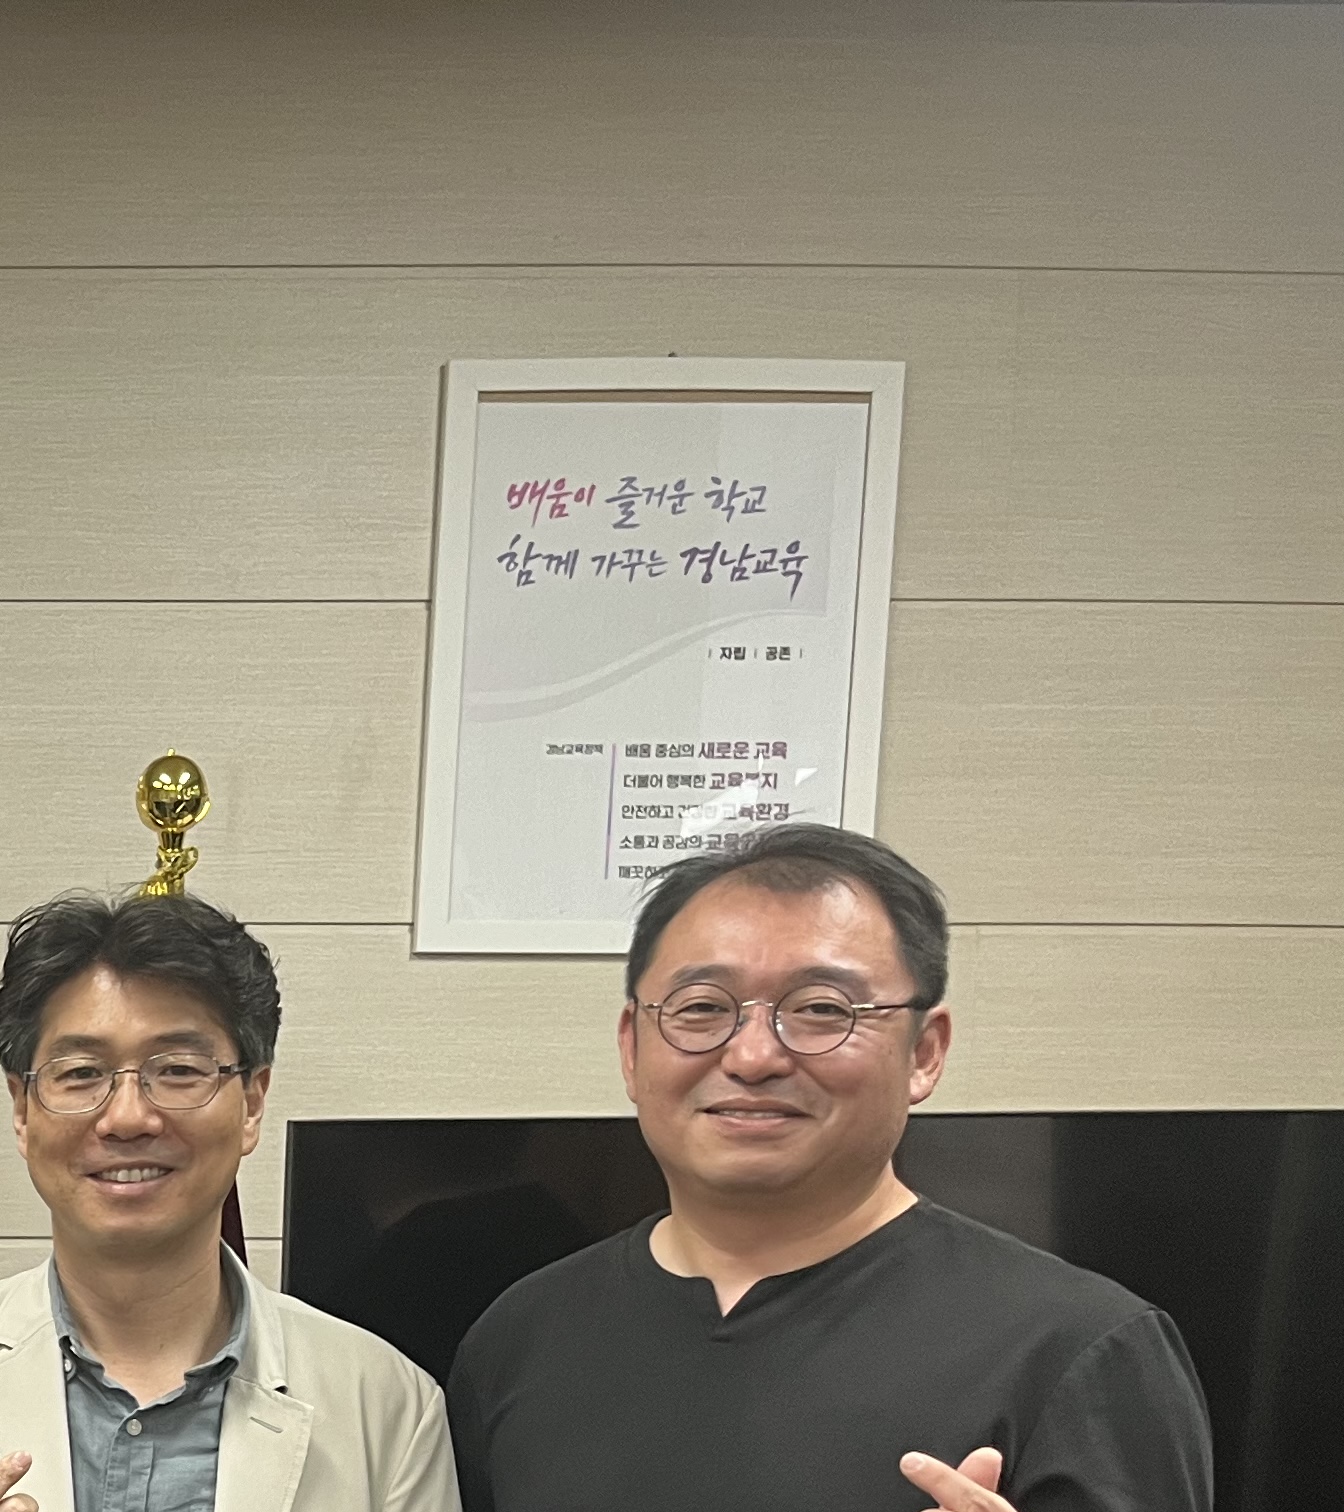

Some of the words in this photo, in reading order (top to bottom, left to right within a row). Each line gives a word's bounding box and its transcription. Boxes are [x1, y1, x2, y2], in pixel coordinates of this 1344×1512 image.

[506, 477, 597, 527] 배움이
[604, 476, 695, 529] 즐거운
[704, 476, 767, 523] 학교
[497, 533, 579, 588] 함께
[591, 548, 668, 583] 가꾸는
[679, 539, 809, 602] 경남교육
[719, 646, 746, 661] 자립
[765, 646, 791, 661] 공존
[625, 743, 651, 758] 배움
[654, 743, 695, 758] 중심의
[698, 741, 750, 760] 새로운
[753, 741, 788, 760] 교육
[623, 773, 663, 789] 더불어
[666, 773, 706, 789] 행복한
[621, 804, 674, 819] 안전하고
[619, 835, 659, 850] 소통과
